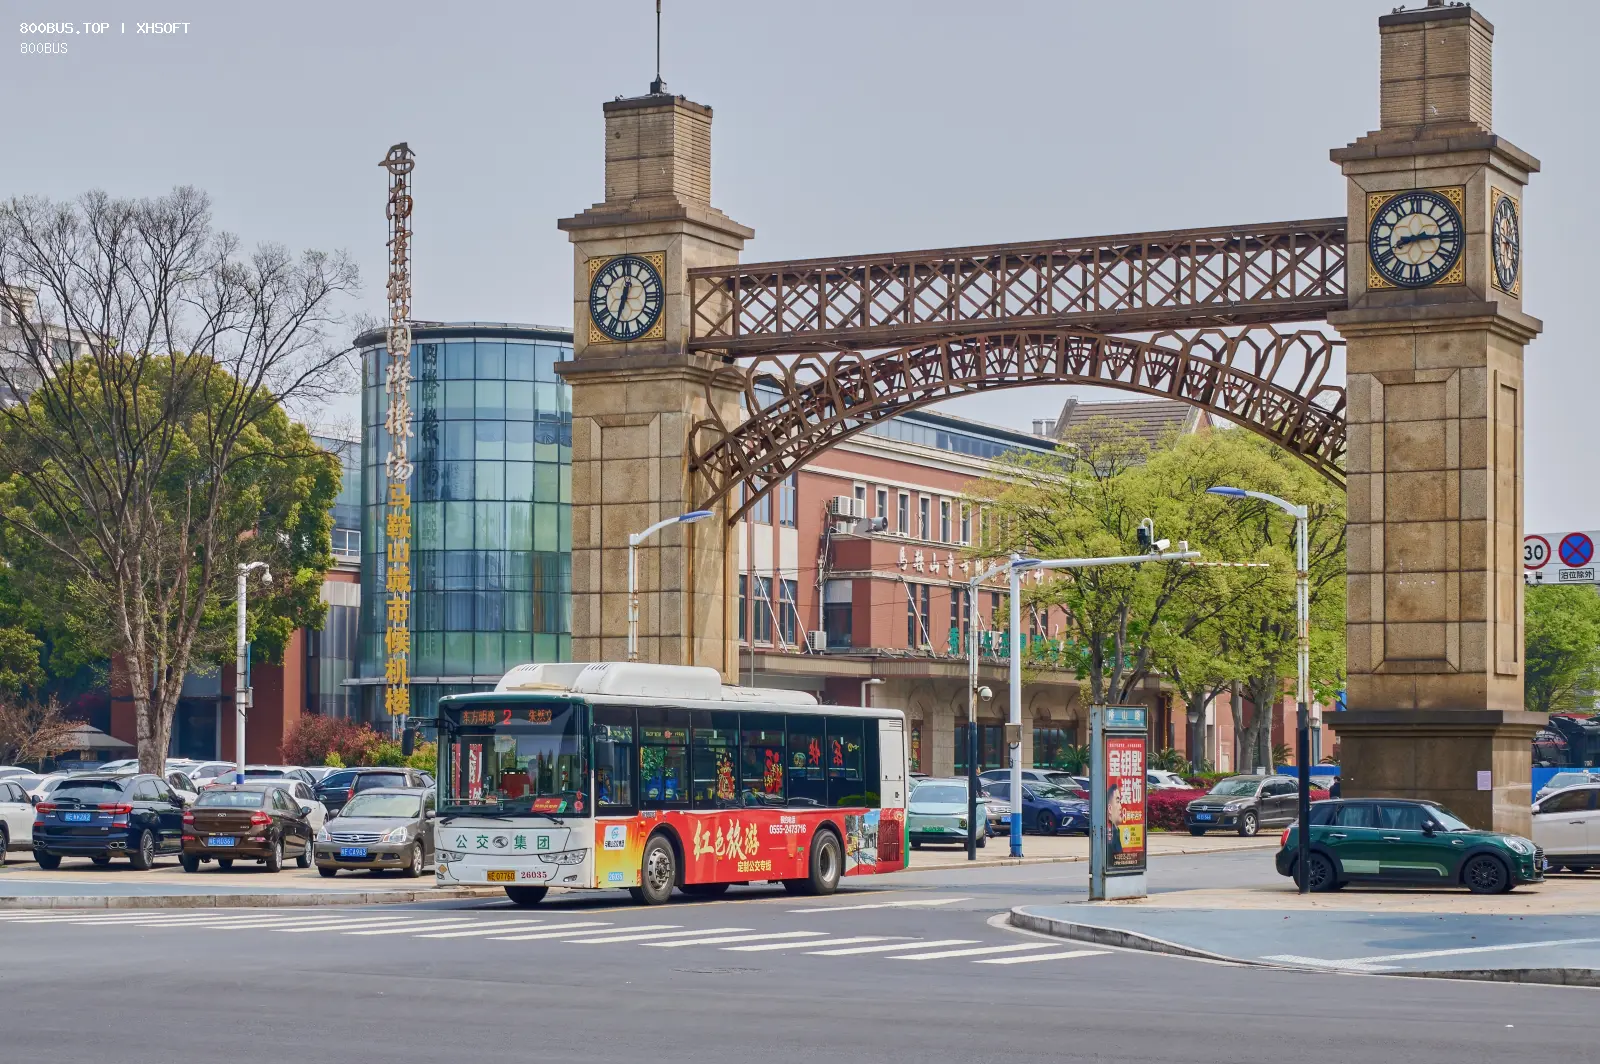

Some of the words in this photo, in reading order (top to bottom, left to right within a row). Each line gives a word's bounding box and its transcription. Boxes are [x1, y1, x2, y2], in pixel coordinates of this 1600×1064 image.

[1524, 545, 1543, 561] 30
[1561, 570, 1593, 580] 泊位除外
[384, 483, 412, 716] 马鞍山城市候机楼
[463, 709, 496, 725] 东方明珠
[503, 709, 513, 725] 2
[1109, 750, 1142, 776] 金钥匙
[1121, 778, 1142, 804] 装饰
[693, 818, 760, 862] 红色旅游
[737, 860, 772, 872] 定制公交专线
[520, 871, 548, 879] 26035
